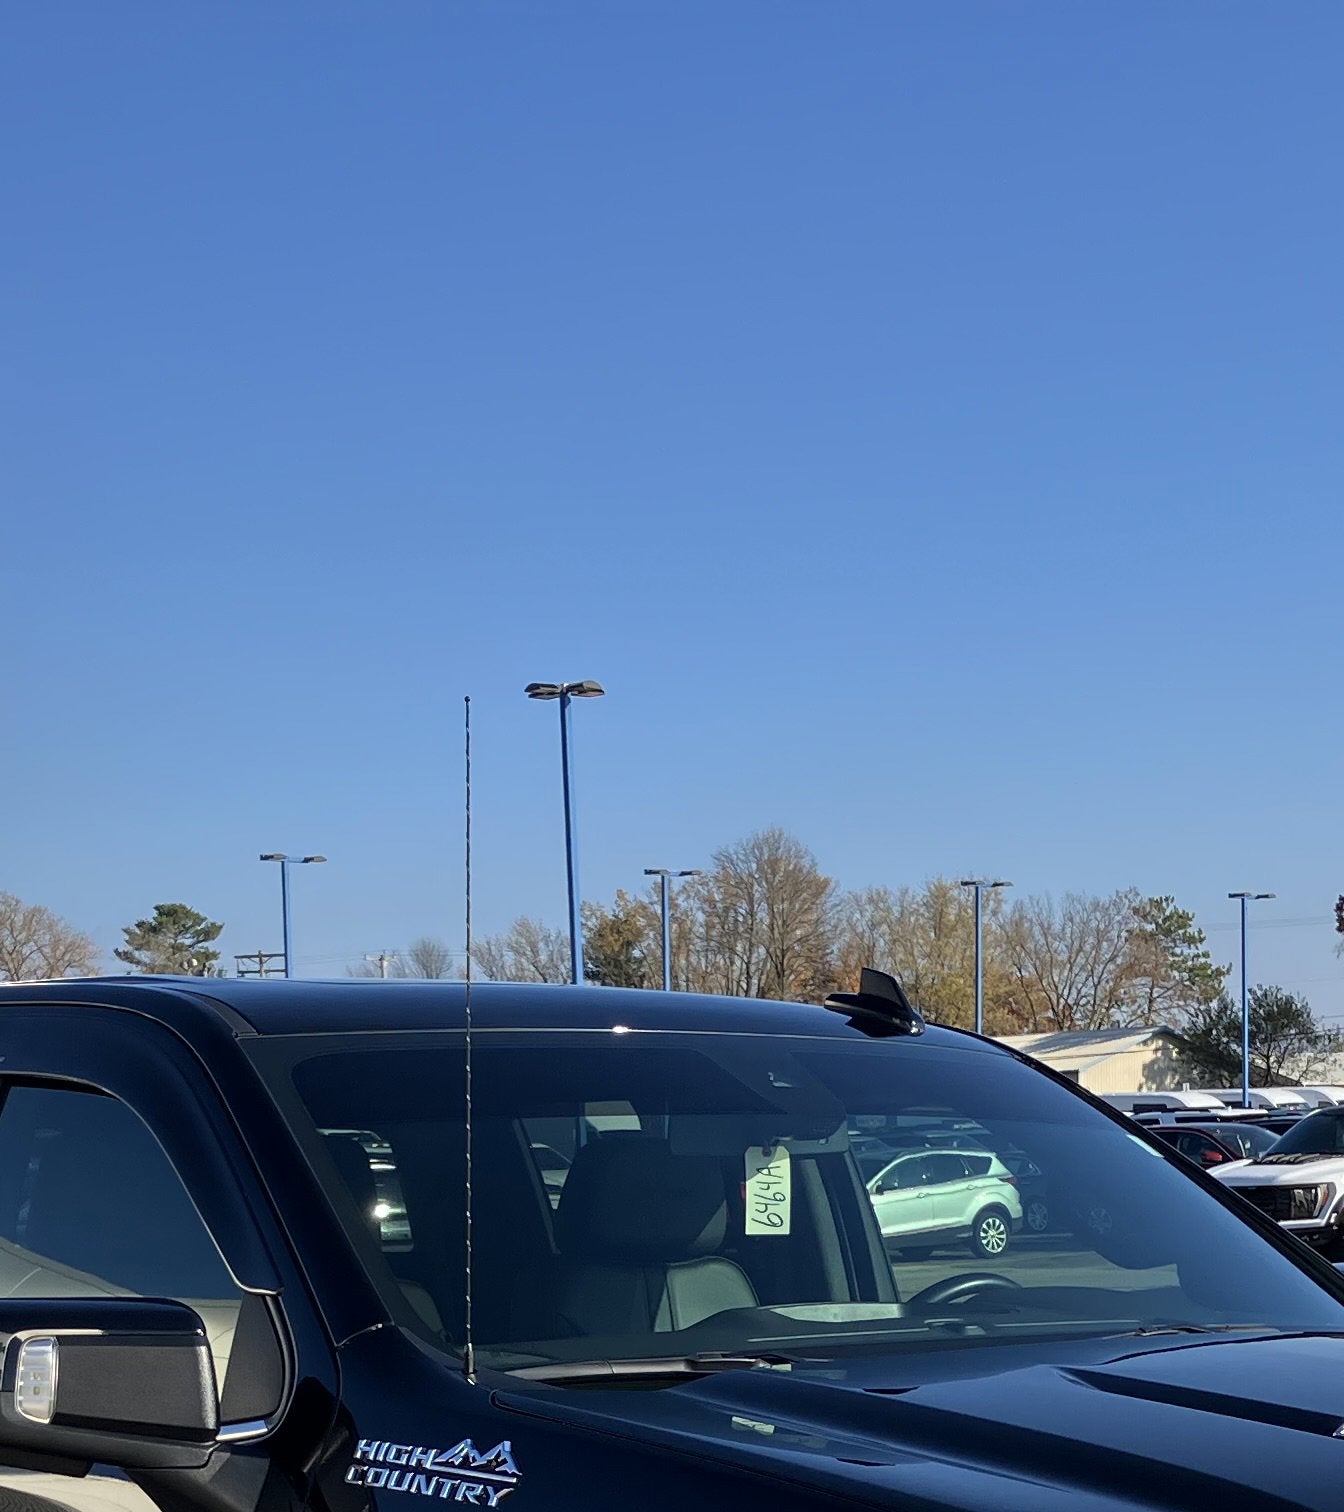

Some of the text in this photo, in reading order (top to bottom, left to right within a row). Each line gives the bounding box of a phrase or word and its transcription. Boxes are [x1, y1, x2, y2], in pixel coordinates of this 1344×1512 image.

[750, 1165, 786, 1228] 6464A
[353, 1438, 440, 1469] HIGH
[344, 1463, 516, 1508] COUNTRY
